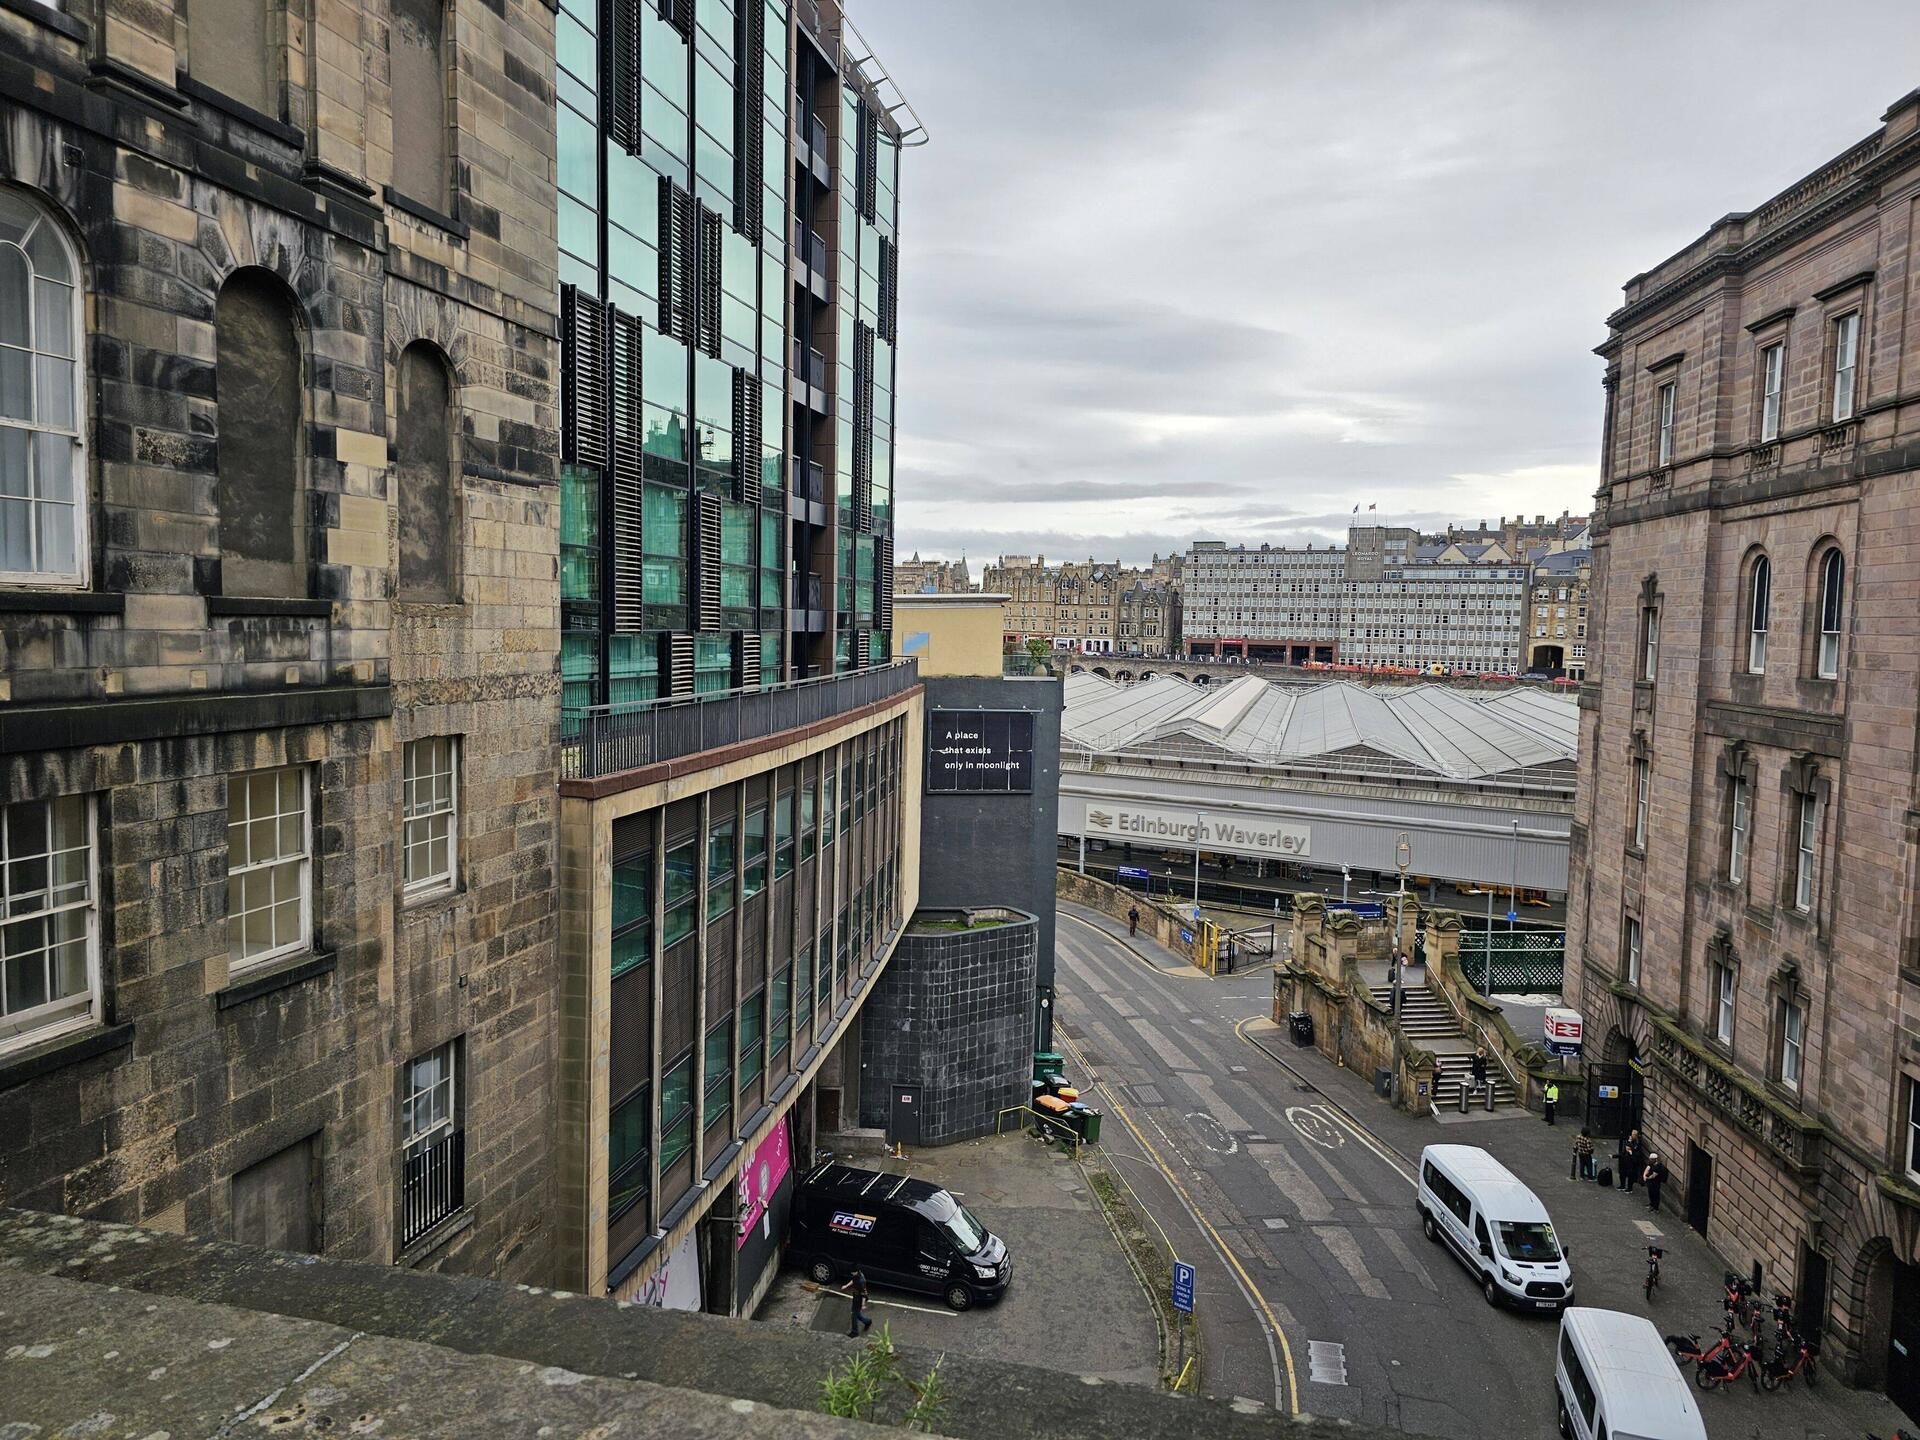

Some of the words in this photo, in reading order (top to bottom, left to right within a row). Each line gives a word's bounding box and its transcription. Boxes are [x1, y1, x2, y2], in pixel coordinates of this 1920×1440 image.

[946, 731, 952, 739] A
[954, 731, 979, 741] place
[945, 746, 963, 754] that
[965, 746, 992, 754] exists
[944, 761, 963, 770] only
[965, 761, 974, 769] in
[976, 761, 1020, 770] moonlight
[1118, 812, 1210, 842] Edinburgh
[1214, 822, 1306, 854] Waverley
[833, 1214, 872, 1230] FFDR
[1180, 1267, 1189, 1283] P
